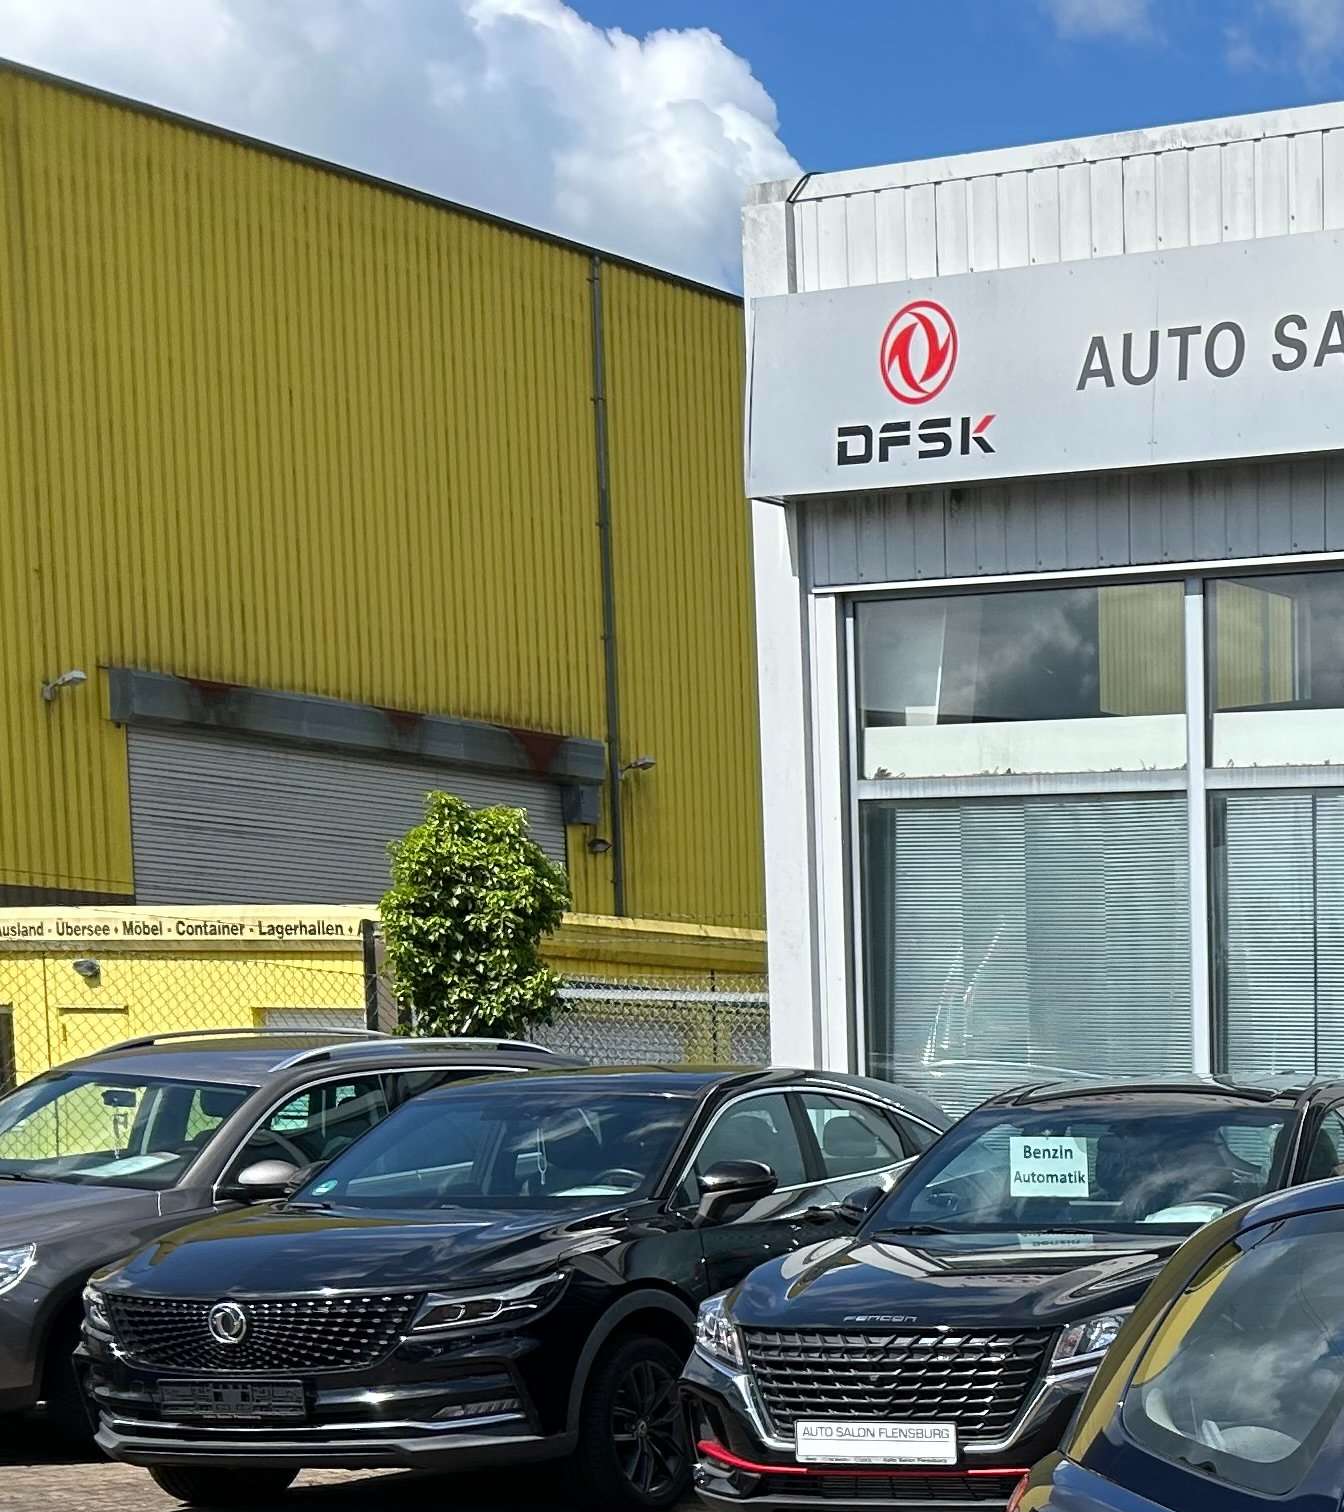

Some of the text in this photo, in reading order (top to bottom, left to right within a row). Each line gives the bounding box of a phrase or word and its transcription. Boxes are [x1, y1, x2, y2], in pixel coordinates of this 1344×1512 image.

[1076, 320, 1246, 392] AUTO
[836, 414, 997, 466] DFSK
[0, 918, 344, 939] usland Übersee Möbel Container Lagerhallen
[1023, 1145, 1073, 1160] Benzin
[1014, 1171, 1086, 1184] Automatik
[802, 1426, 950, 1439] AUTO SALON FLENSBURG
